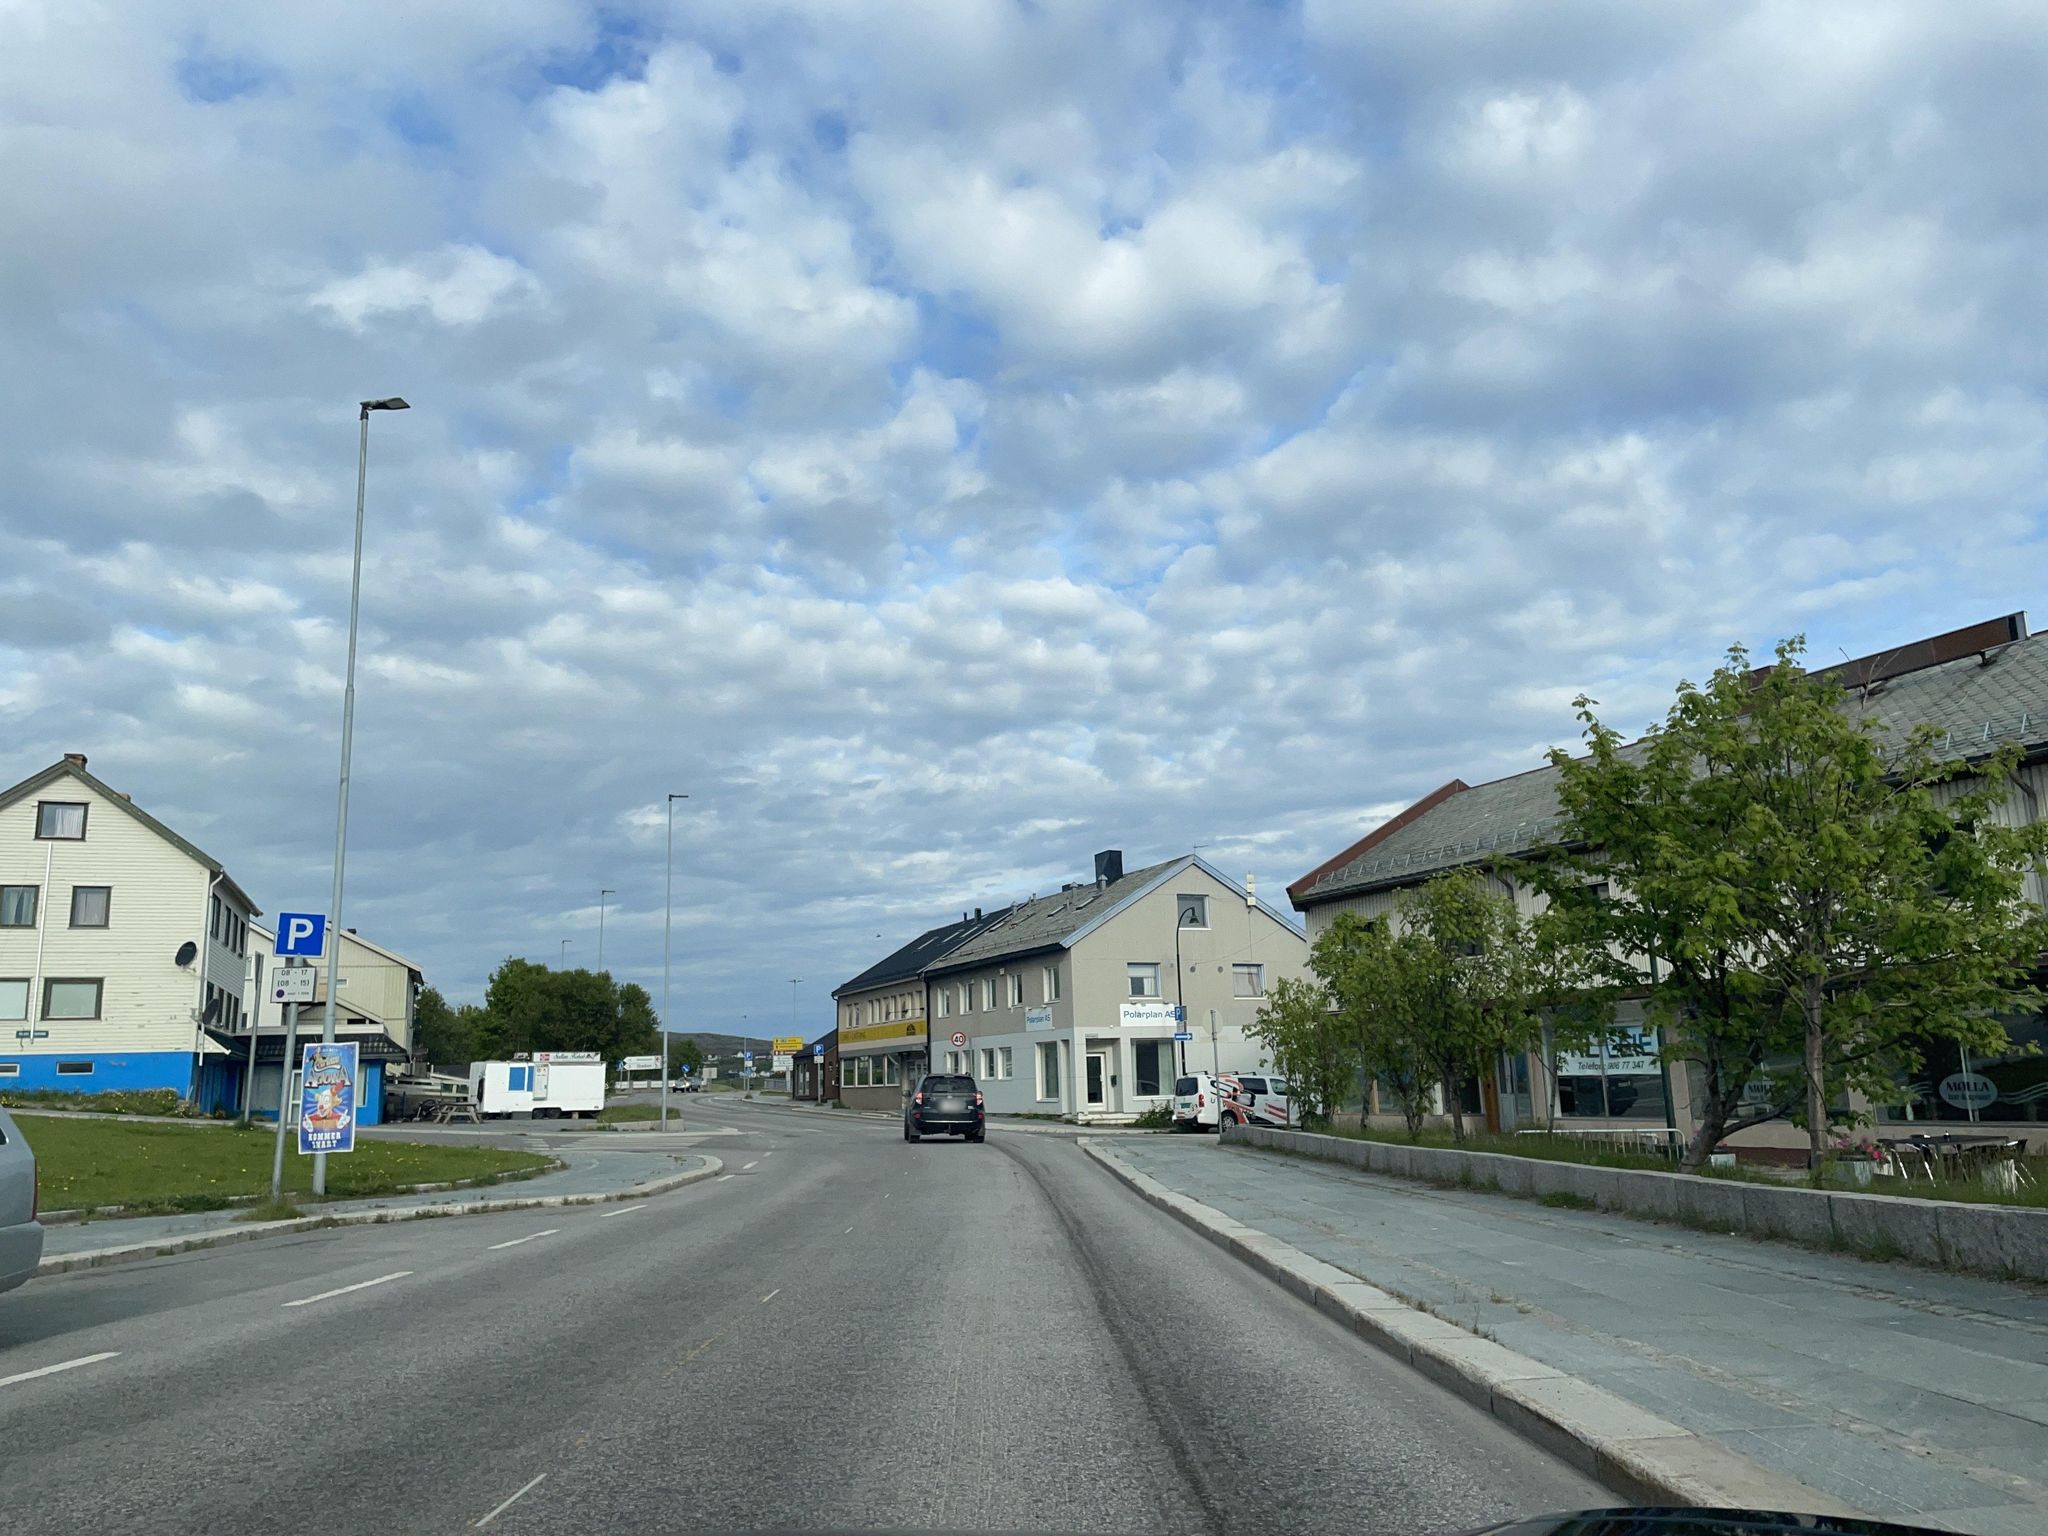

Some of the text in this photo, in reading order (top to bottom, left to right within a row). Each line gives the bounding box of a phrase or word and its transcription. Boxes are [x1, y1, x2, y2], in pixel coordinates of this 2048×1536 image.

[287, 918, 314, 950] P
[1124, 1010, 1163, 1020] Polarplan
[1622, 1061, 1631, 1069] 77
[1632, 1061, 1645, 1069] 347
[308, 1132, 341, 1141] KOMMER
